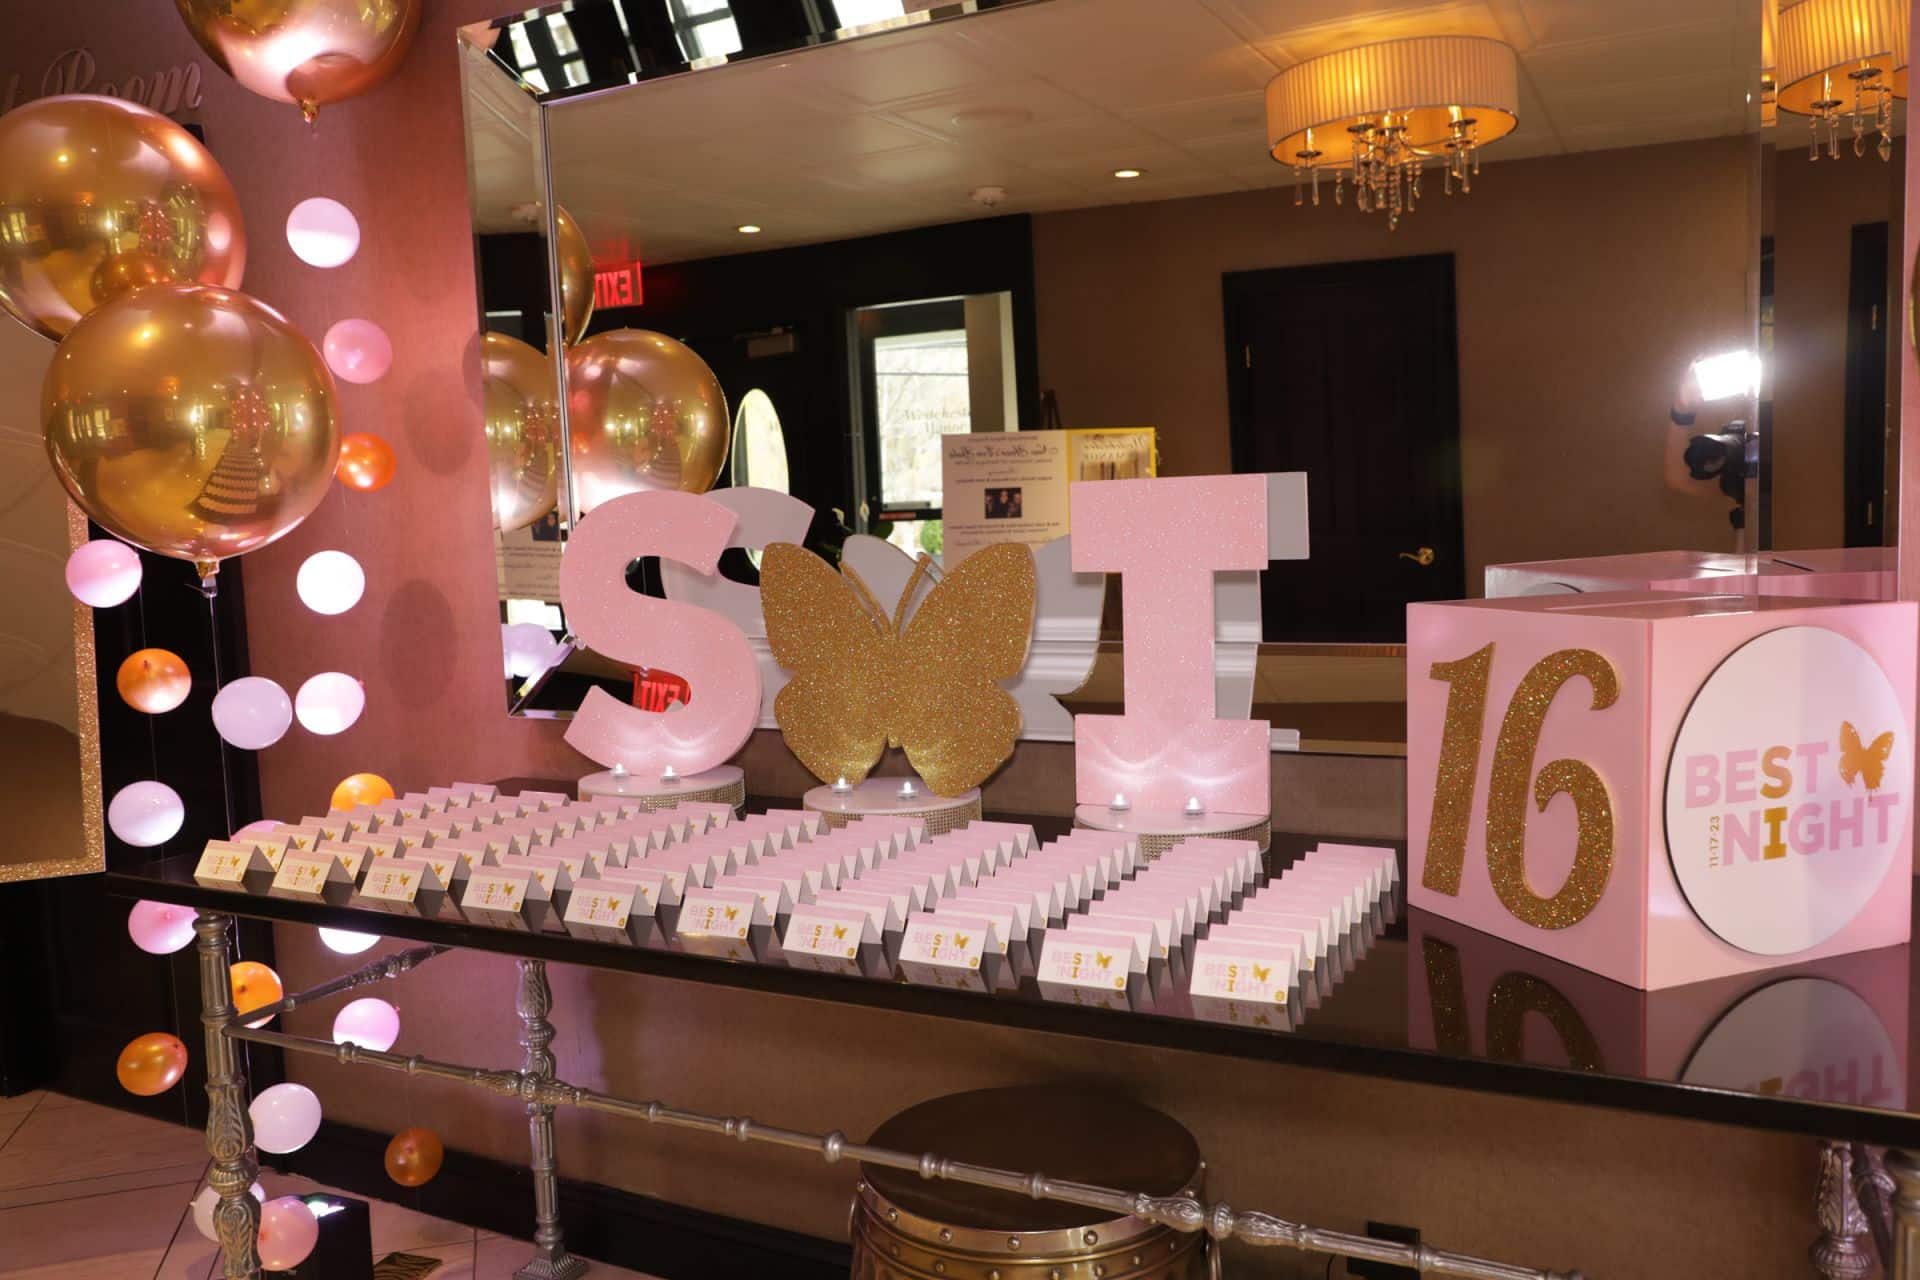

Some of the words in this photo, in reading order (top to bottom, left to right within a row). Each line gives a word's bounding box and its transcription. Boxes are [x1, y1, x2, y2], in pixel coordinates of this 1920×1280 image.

[1422, 641, 1620, 930] 16
[1684, 741, 1828, 809] BEST
[1722, 793, 1899, 867] NIGHT
[1205, 963, 1250, 978] BEST
